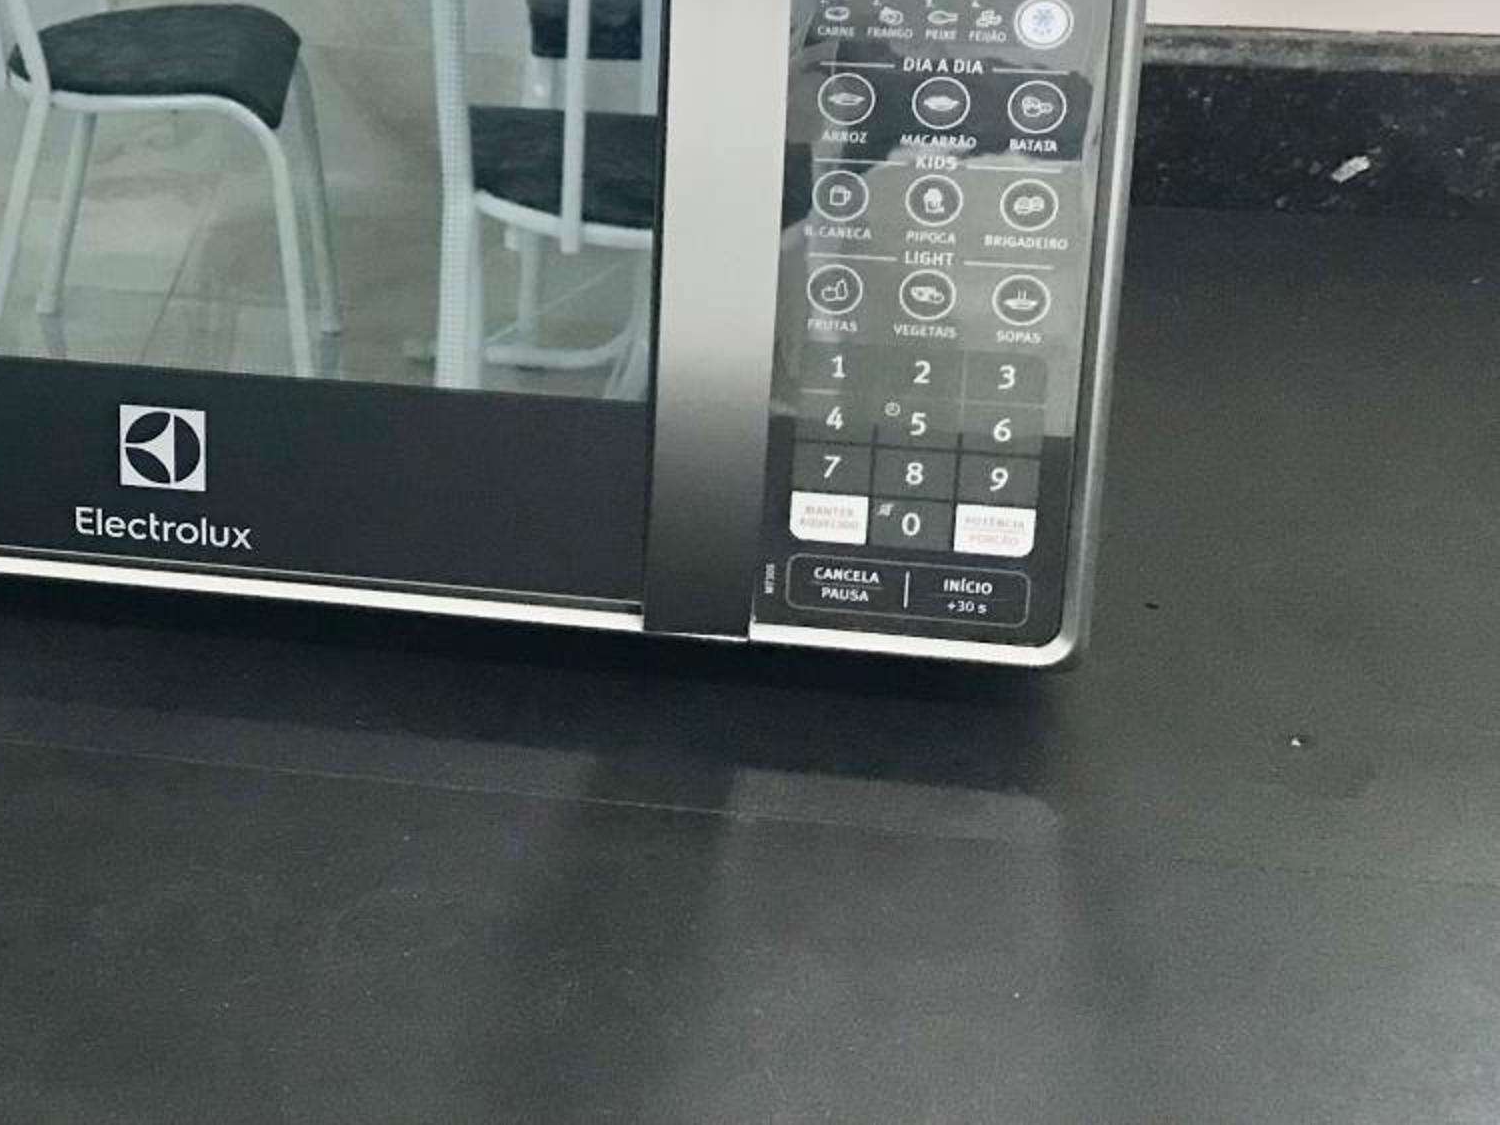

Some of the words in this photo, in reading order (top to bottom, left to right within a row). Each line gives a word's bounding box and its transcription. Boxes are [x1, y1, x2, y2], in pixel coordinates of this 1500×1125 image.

[817, 26, 854, 37] CARNE
[867, 27, 913, 39] FRANGO
[925, 29, 957, 40] PEIXE
[903, 57, 932, 72] DIA
[937, 58, 949, 73] A
[953, 59, 984, 74] DIA
[821, 131, 868, 143] ARROZ
[900, 134, 977, 149] MACARRÃO
[916, 156, 958, 171] KIDS
[906, 230, 956, 244] PIPOCA
[984, 235, 1069, 250] BRIGADEIRO
[904, 250, 955, 267] LIGHT
[807, 318, 857, 332] FRUTAS
[893, 324, 957, 339] VEGETAIS
[996, 330, 1042, 344] SOPAS
[830, 355, 846, 378] 1
[912, 360, 932, 385] 2
[997, 365, 1017, 390] 3
[825, 406, 844, 430] 4
[910, 412, 928, 436] 5
[993, 418, 1012, 442] 6
[823, 456, 842, 479] 7
[905, 462, 924, 486] 8
[989, 468, 1009, 492] 9
[75, 506, 252, 550] Electrolux
[901, 512, 921, 536] 0
[813, 566, 880, 584] CANCELA
[821, 586, 869, 602] PAUSA
[943, 577, 993, 595] INÍCIO
[947, 600, 975, 614] +30
